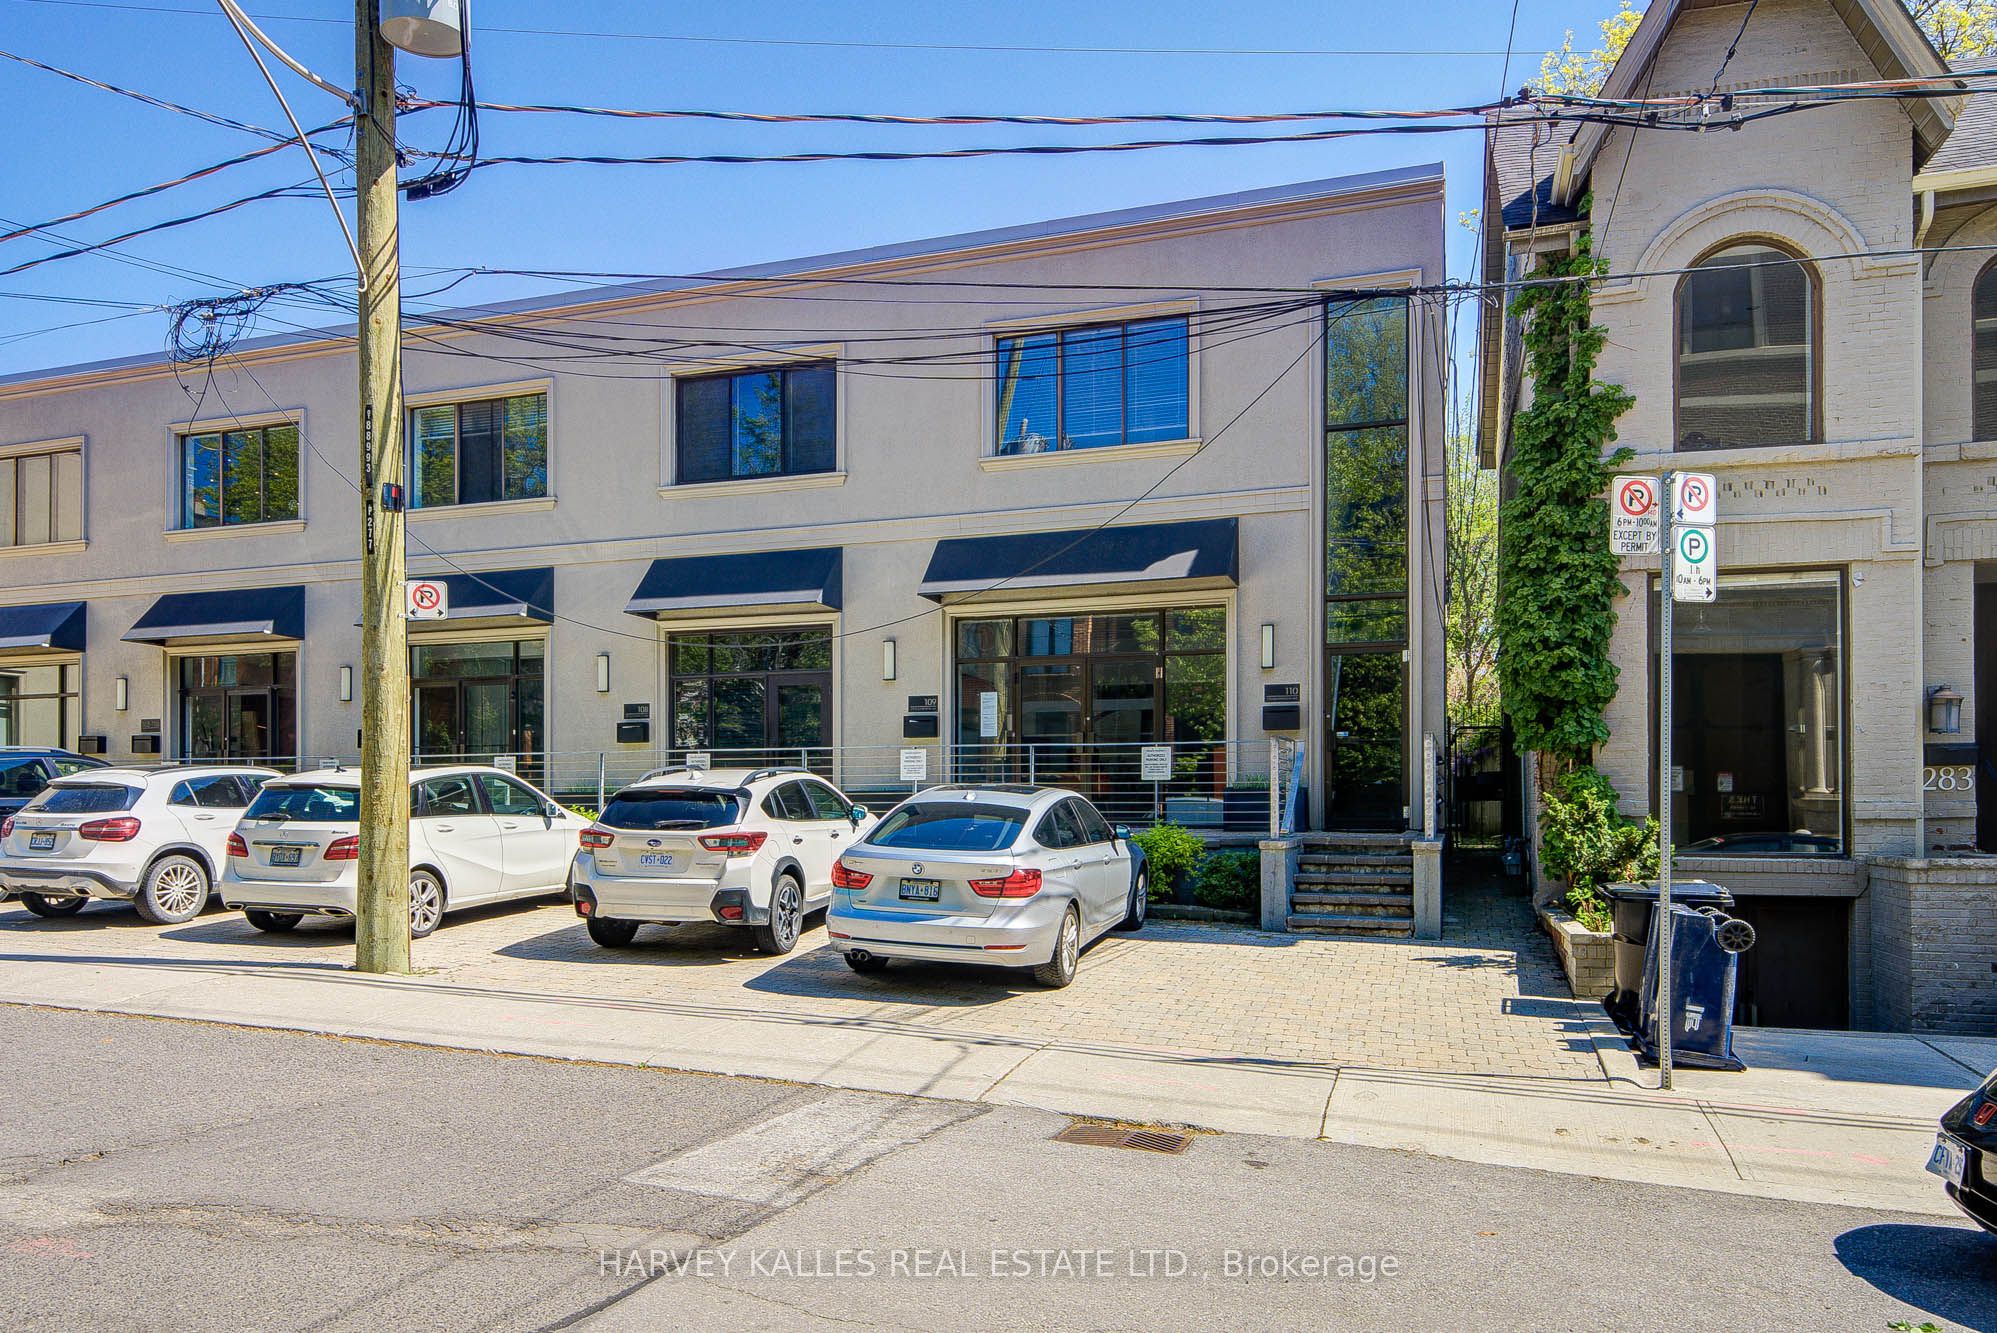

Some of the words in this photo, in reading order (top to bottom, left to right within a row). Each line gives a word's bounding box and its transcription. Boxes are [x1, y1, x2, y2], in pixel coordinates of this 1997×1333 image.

[1613, 530, 1642, 541] EXCEPT
[1646, 531, 1657, 541] BY
[1620, 542, 1648, 552] PERMIT
[1285, 687, 1299, 695] 110
[924, 698, 937, 706] 109
[1922, 766, 1974, 791] 283
